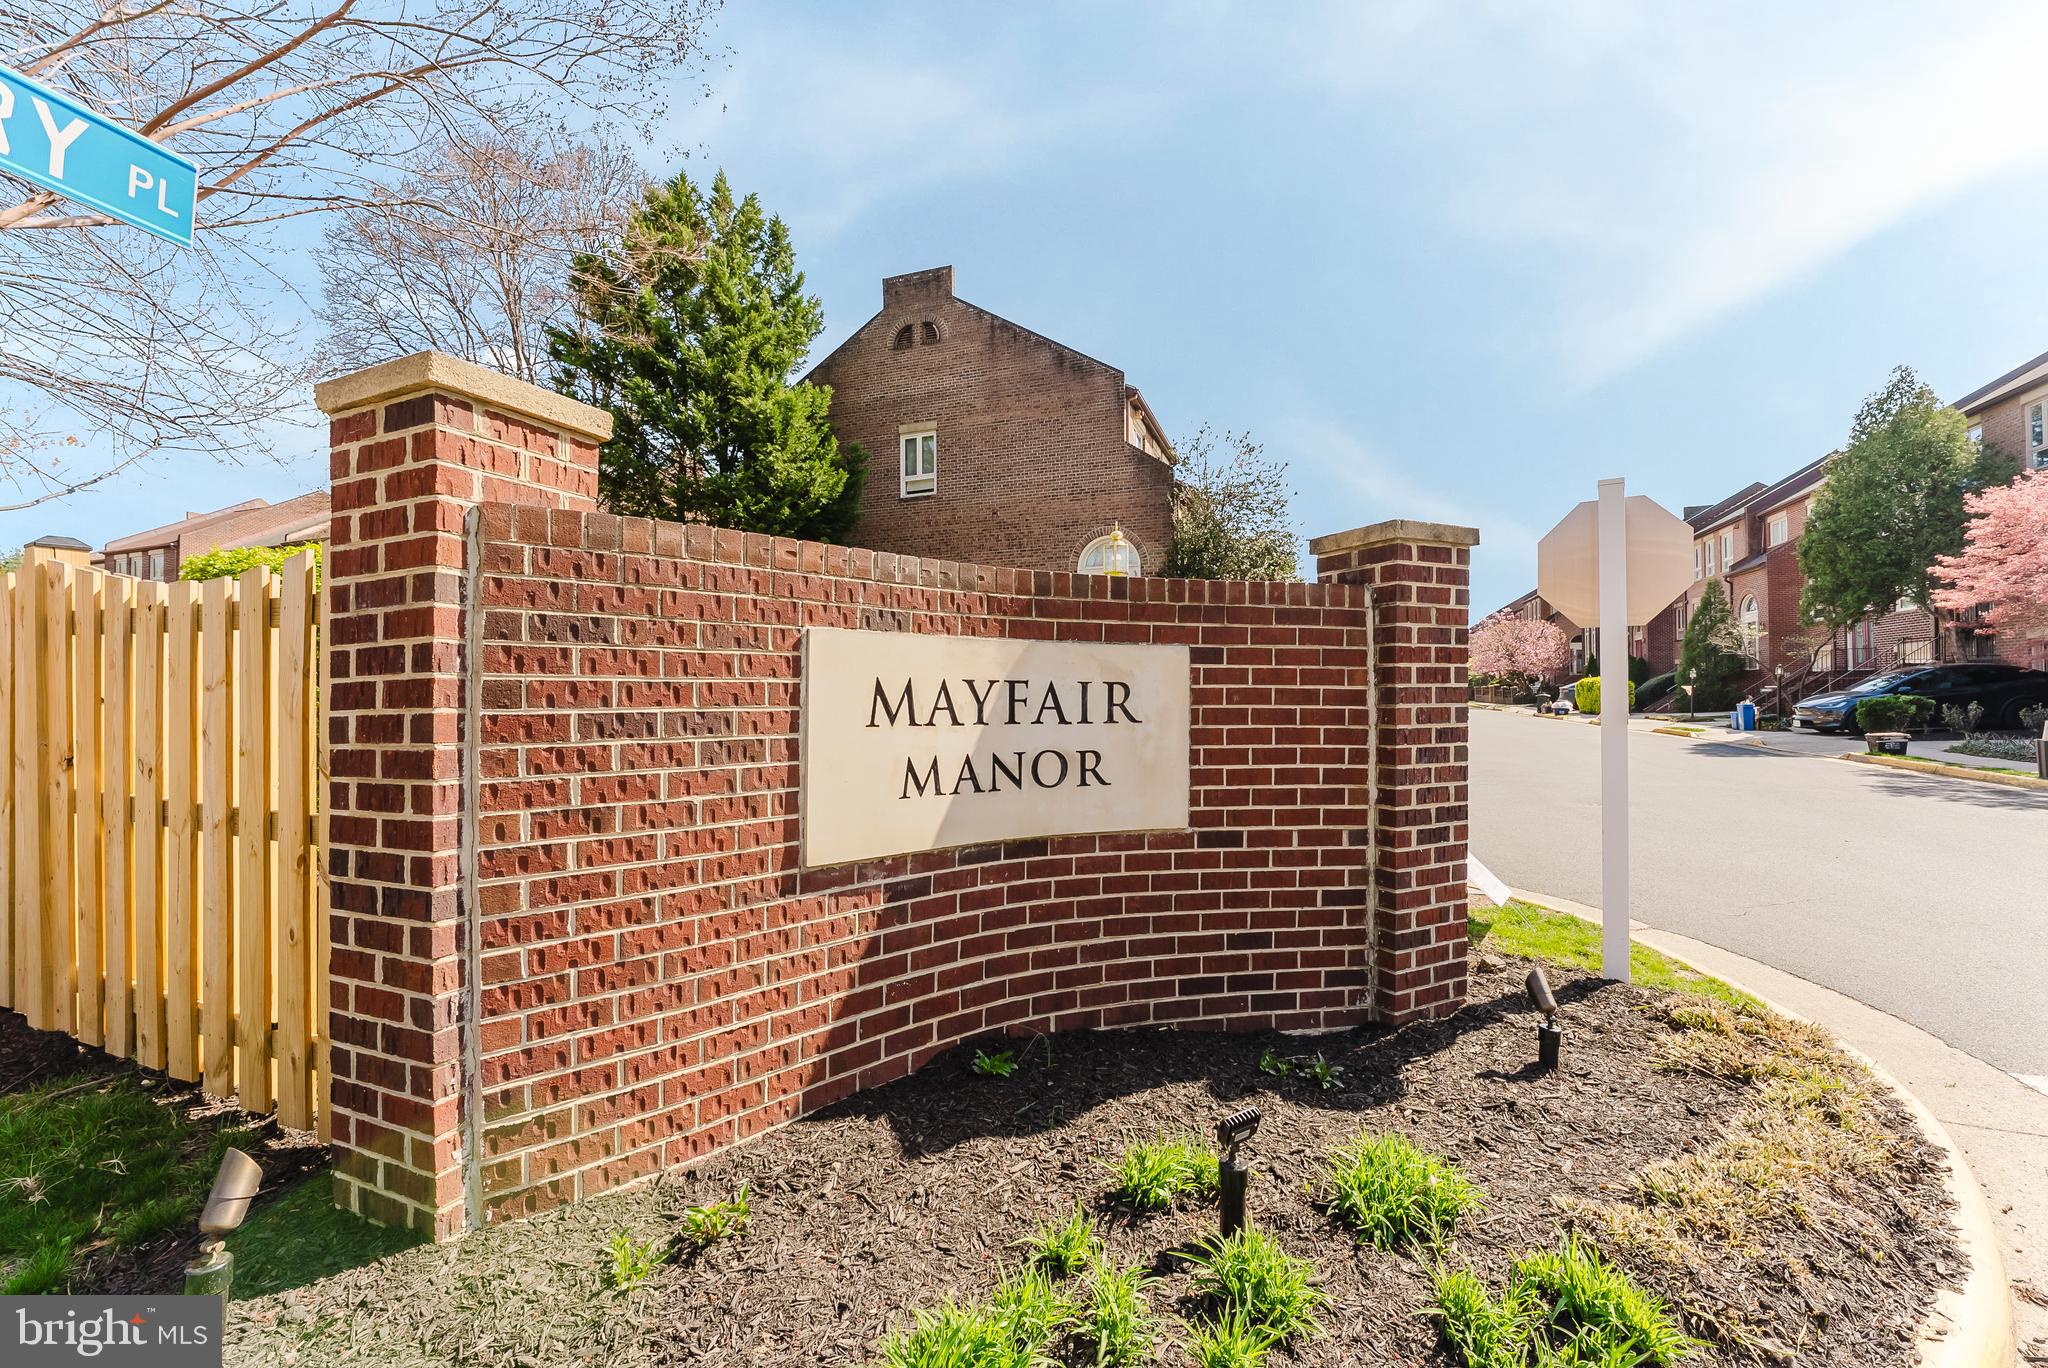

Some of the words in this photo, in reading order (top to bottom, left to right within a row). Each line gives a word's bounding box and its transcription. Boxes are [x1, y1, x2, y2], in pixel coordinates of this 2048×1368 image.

[128, 163, 179, 218] PL
[865, 676, 1143, 728] MAYFAIR
[898, 749, 1111, 800] MANOR
